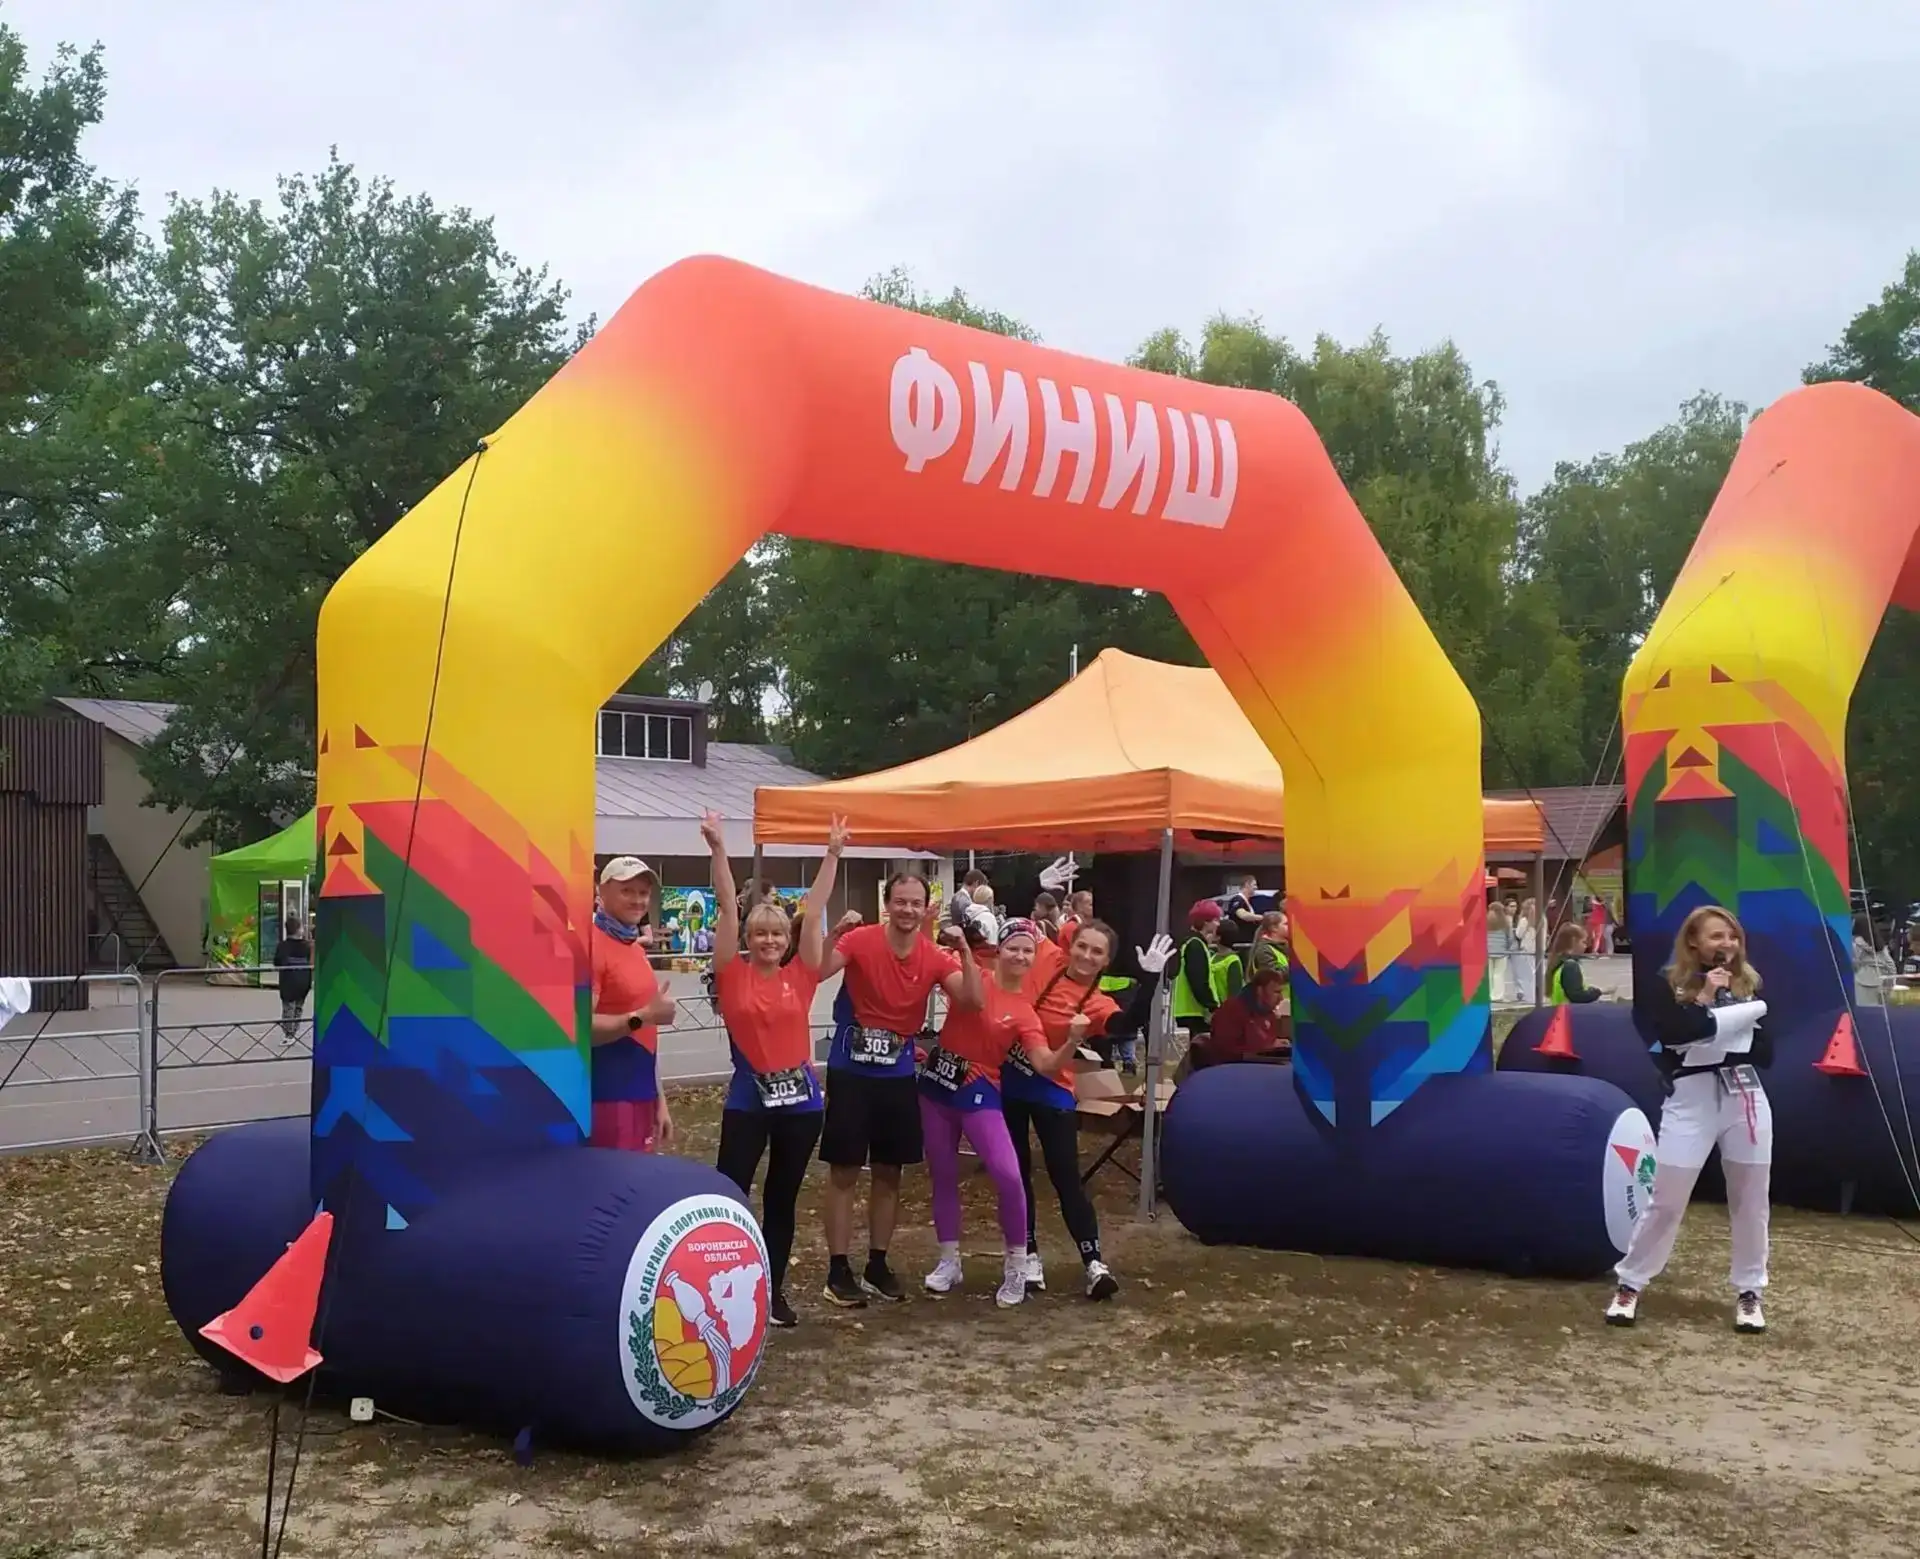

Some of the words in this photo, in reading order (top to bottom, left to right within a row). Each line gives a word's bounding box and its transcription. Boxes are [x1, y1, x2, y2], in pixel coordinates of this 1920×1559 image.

[889, 346, 1239, 530] ФИНИШ
[864, 1037, 890, 1055] 303
[935, 1058, 957, 1079] 303
[769, 1079, 797, 1098] 303
[687, 1239, 748, 1252] ВОРОНЕЖСКАЯ
[639, 1235, 673, 1305] ФЕДЕРАЦИЯ
[669, 1207, 731, 1238] СПОРТИВНОГО
[704, 1252, 741, 1263] ОБЛАСТЬ
